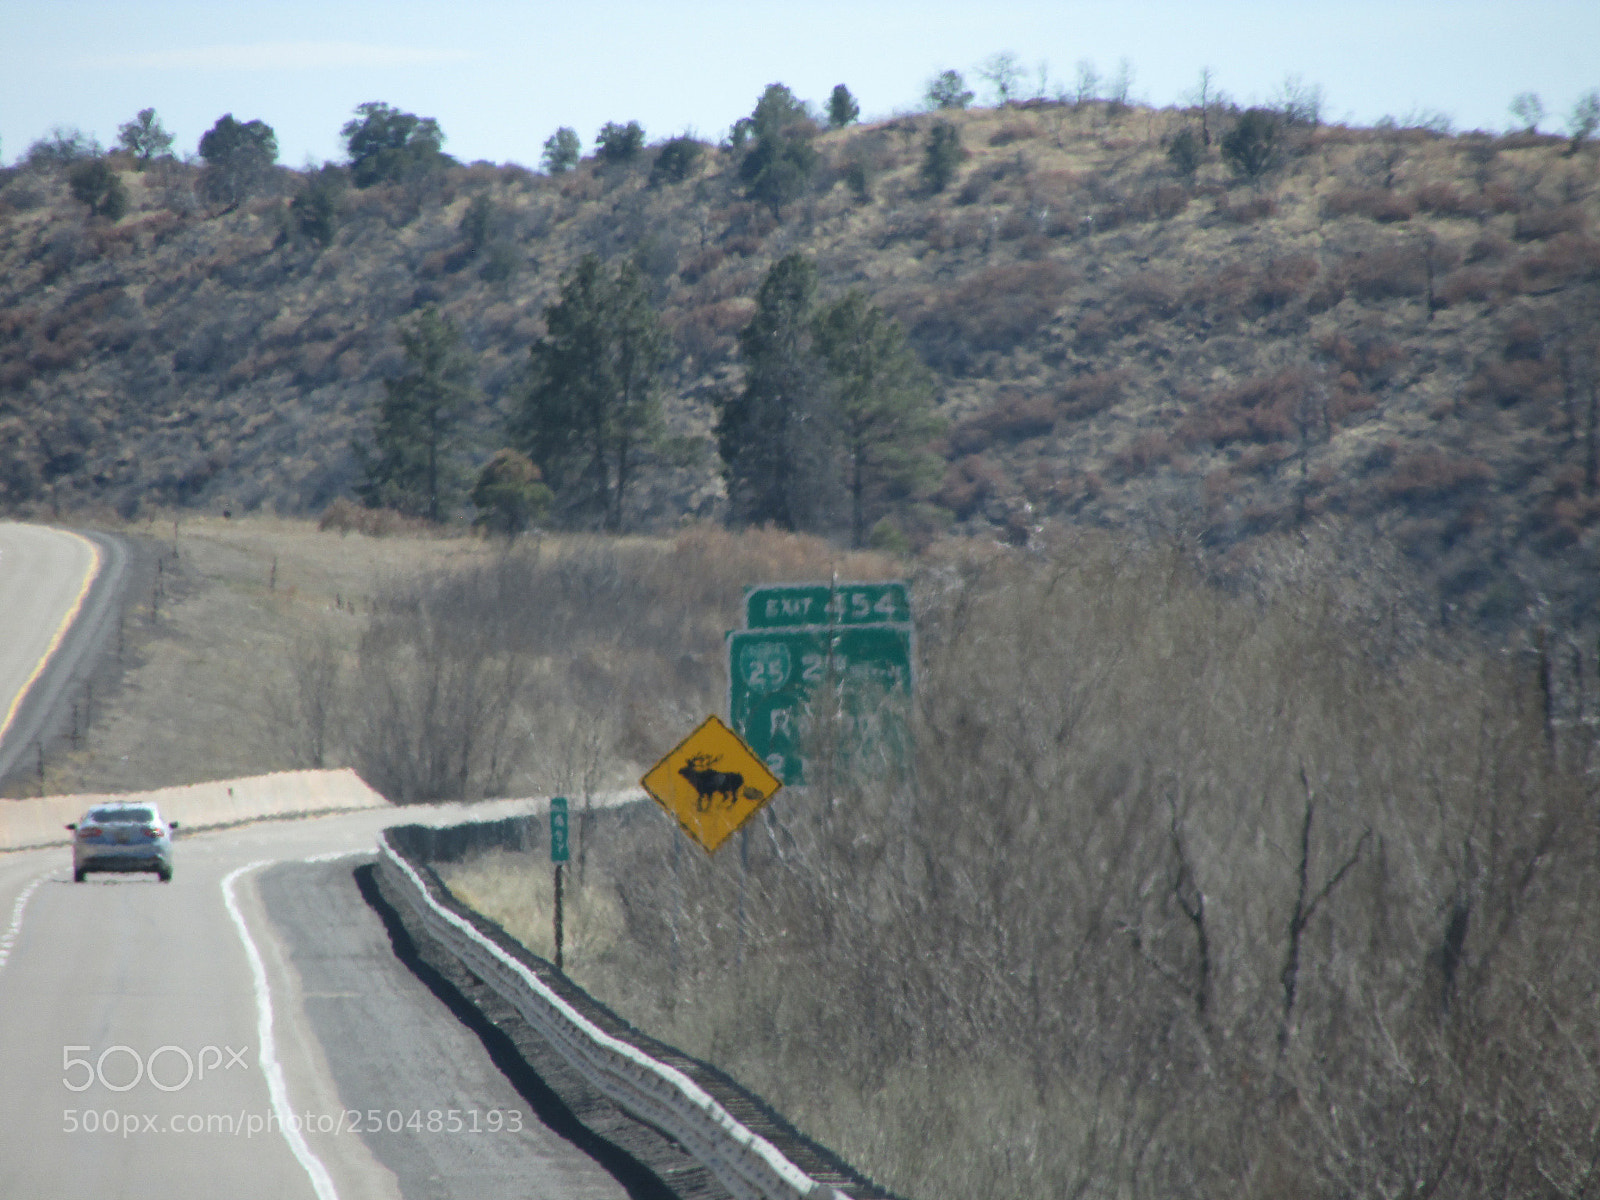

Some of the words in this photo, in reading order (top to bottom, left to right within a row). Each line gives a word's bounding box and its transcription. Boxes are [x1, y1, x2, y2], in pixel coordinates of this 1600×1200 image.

[765, 597, 813, 618] EXIT
[824, 592, 897, 620] 454
[749, 661, 784, 686] 25
